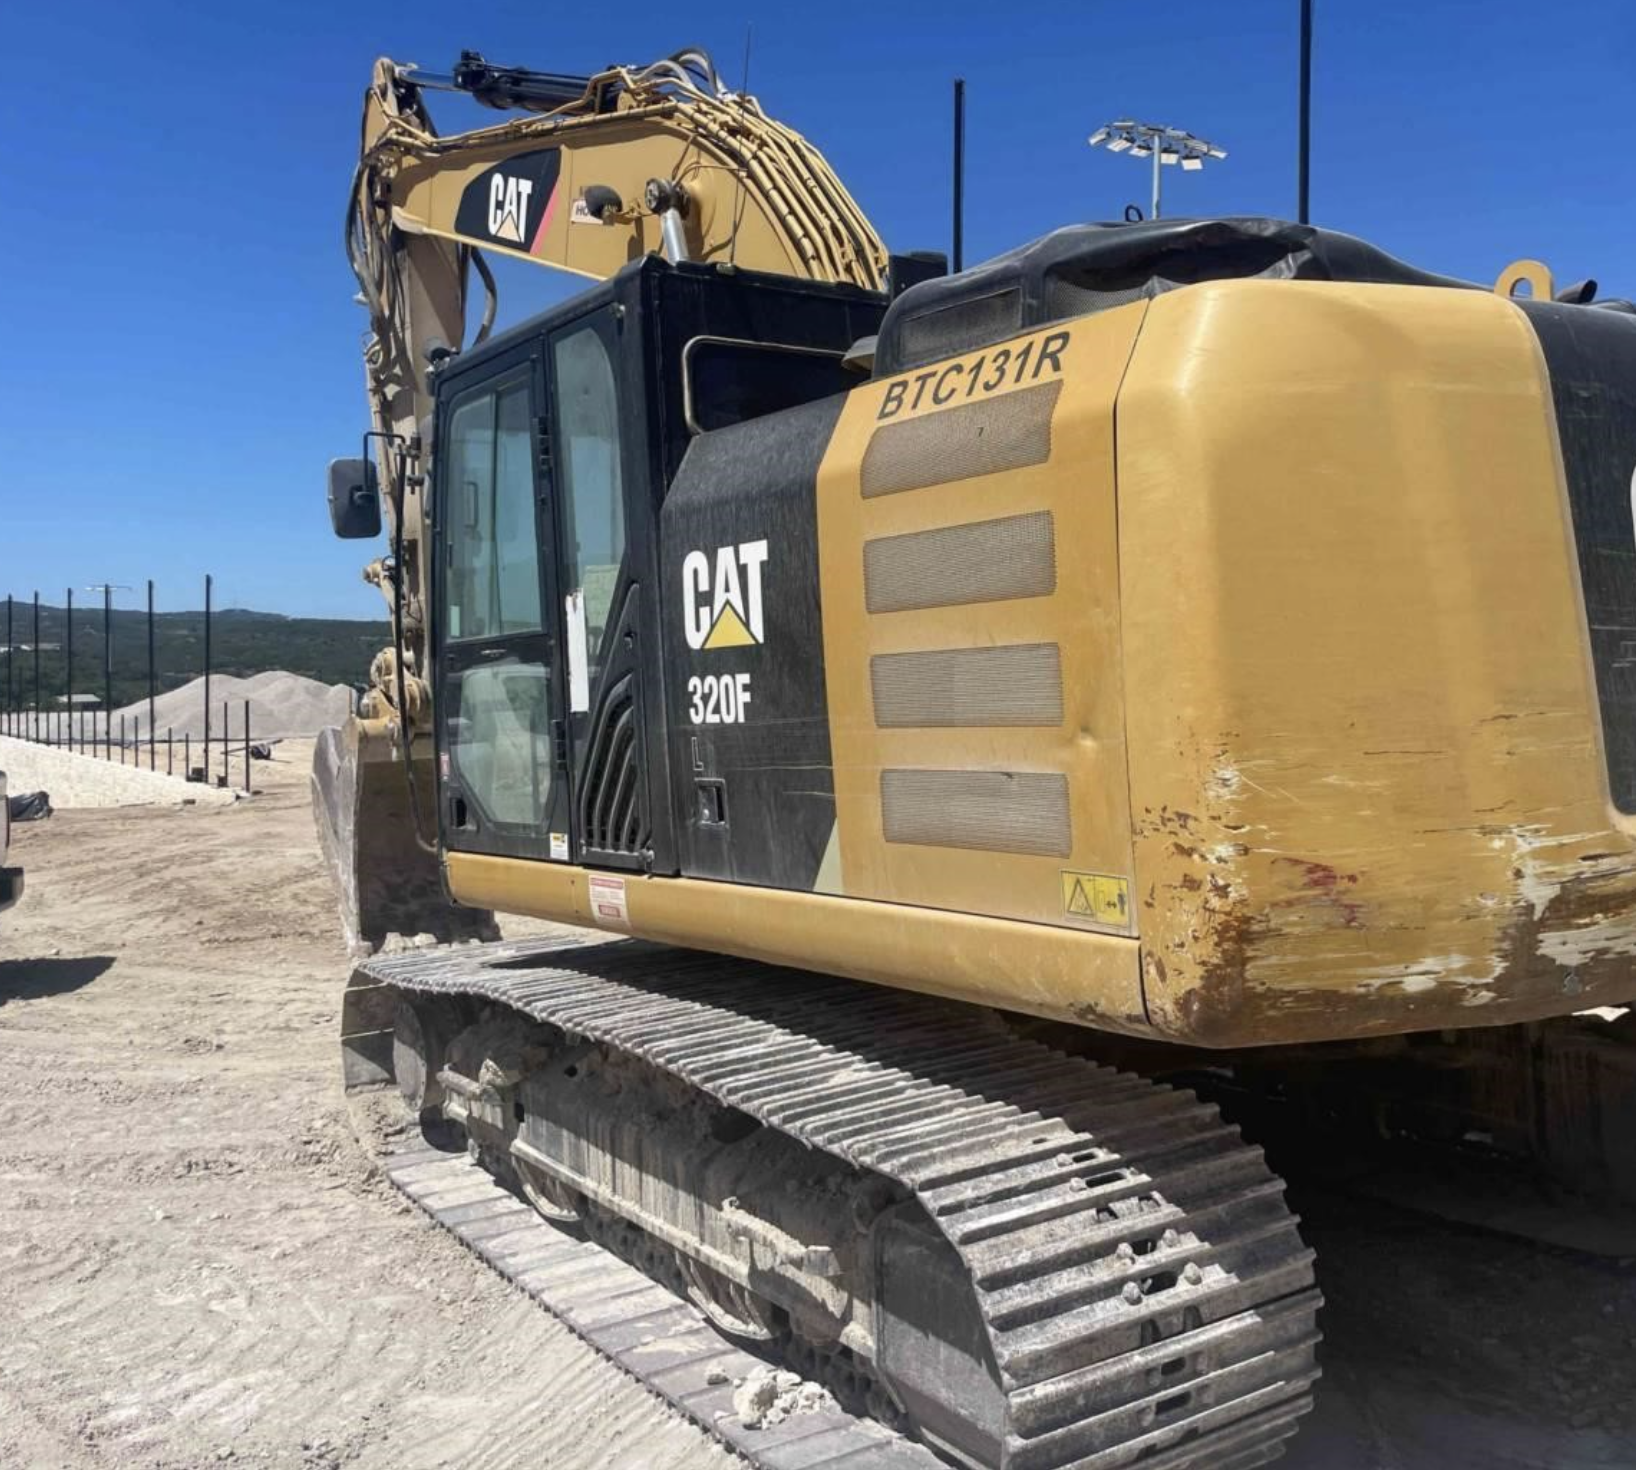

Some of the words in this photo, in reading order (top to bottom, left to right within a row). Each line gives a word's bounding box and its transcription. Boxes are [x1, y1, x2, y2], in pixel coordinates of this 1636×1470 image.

[488, 172, 533, 244] CAT
[877, 331, 1070, 420] BTC131R
[683, 539, 769, 650] CAT
[687, 673, 752, 725] 320F
[691, 736, 704, 771] L
